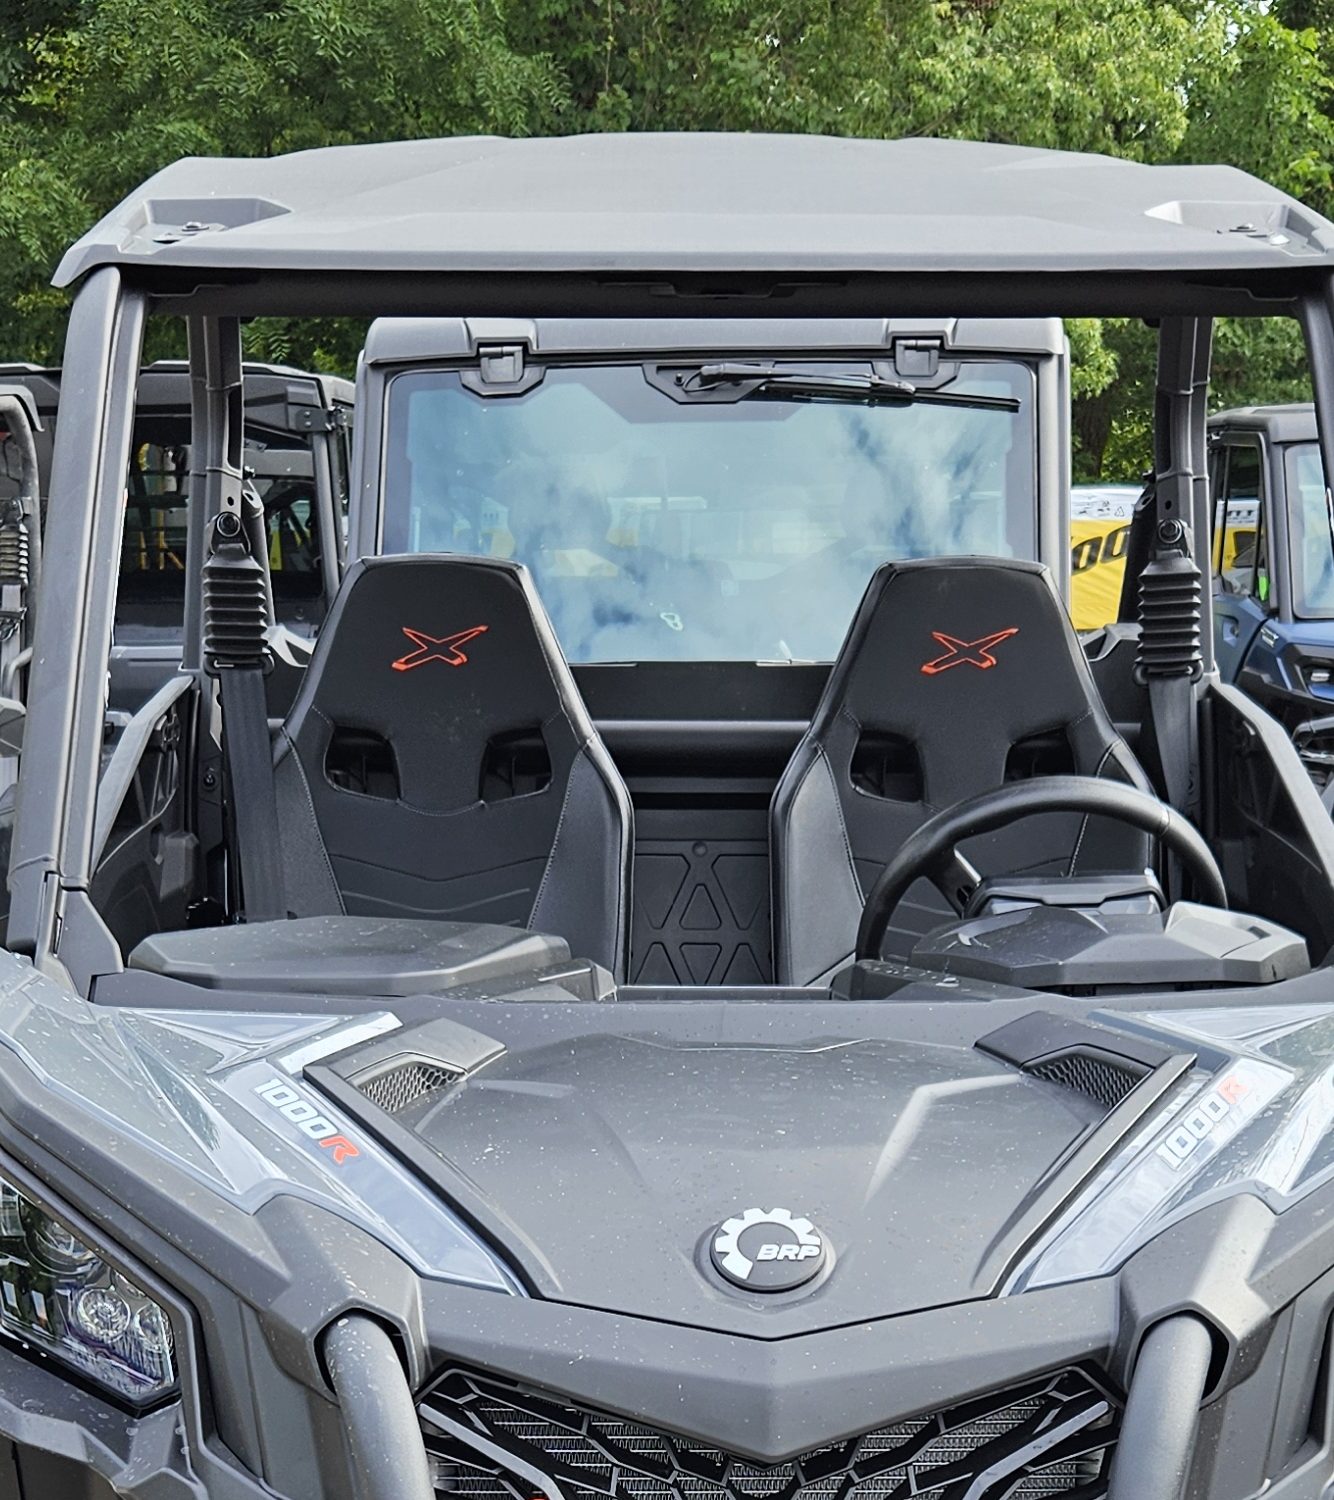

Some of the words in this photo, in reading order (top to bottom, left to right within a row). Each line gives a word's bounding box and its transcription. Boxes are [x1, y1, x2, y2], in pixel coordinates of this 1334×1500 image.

[253, 1078, 360, 1165] 1000R
[1155, 1075, 1249, 1169] 1000R
[756, 1243, 821, 1261] BRP
